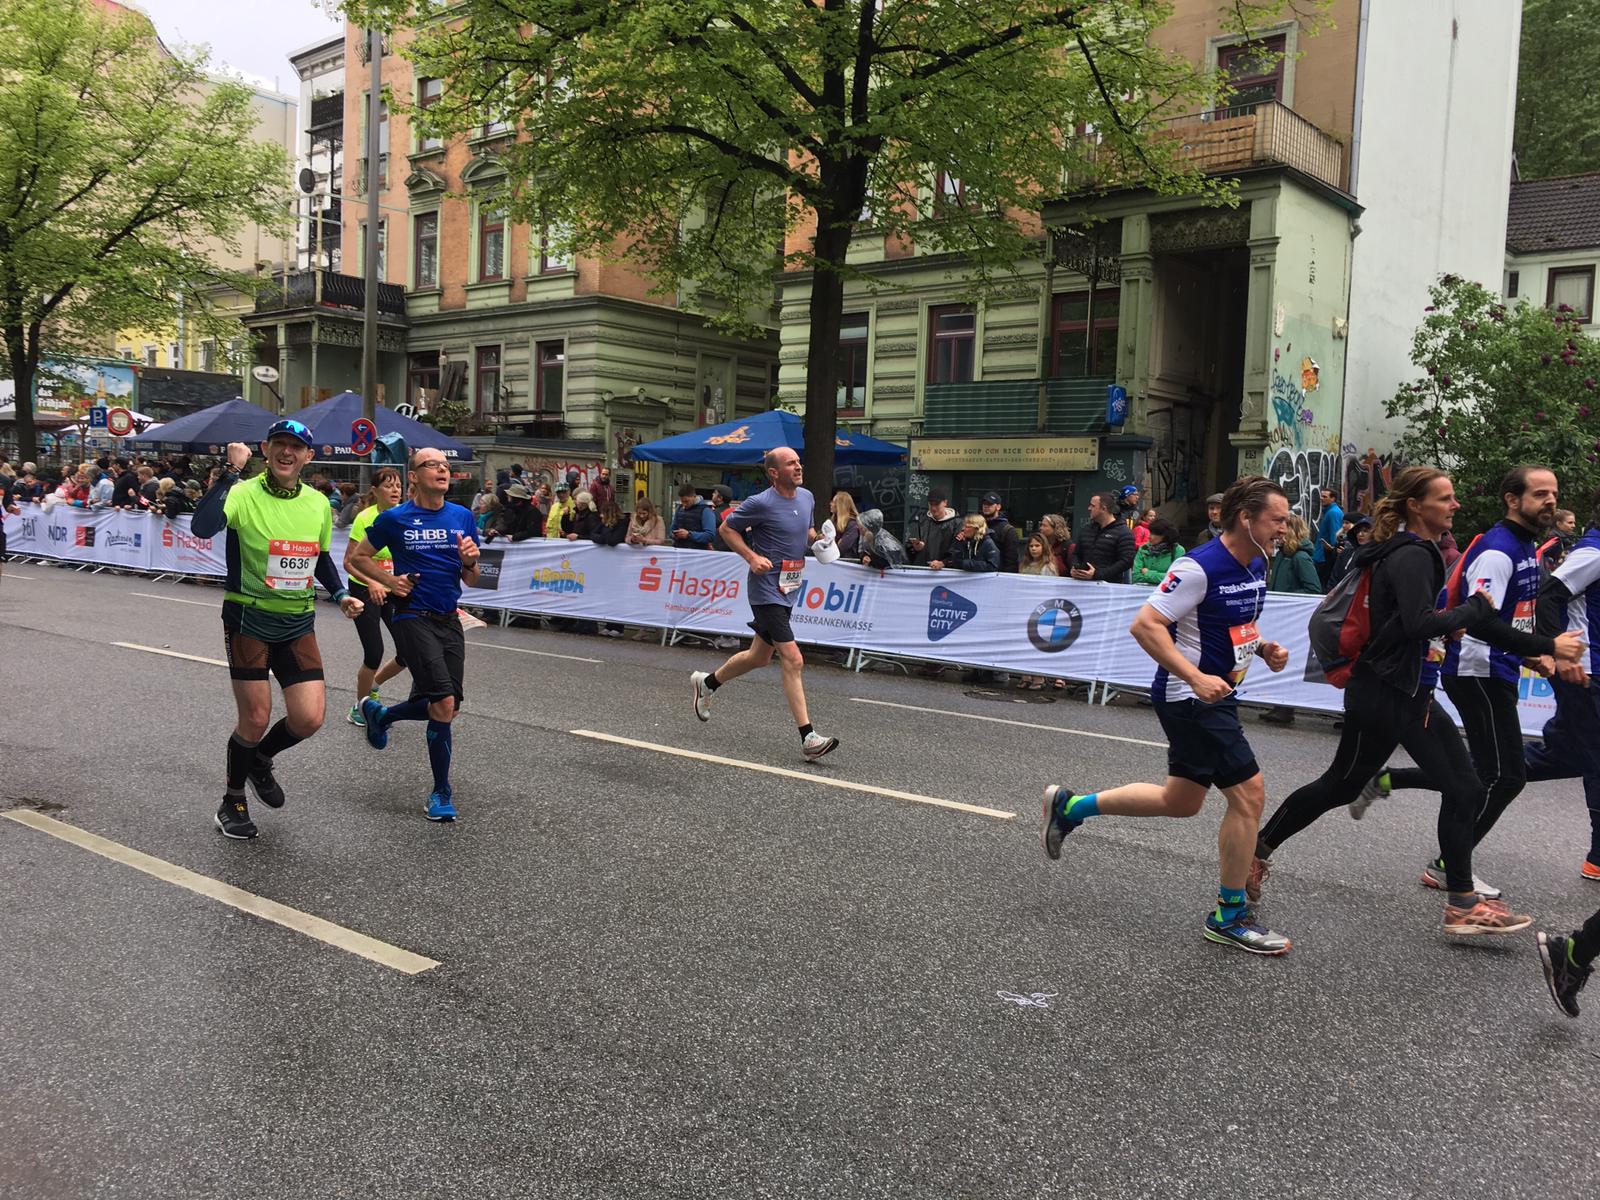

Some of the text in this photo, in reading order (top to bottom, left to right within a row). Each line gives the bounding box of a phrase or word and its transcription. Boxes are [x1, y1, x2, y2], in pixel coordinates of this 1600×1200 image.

[48, 525, 68, 542] NDR
[403, 528, 448, 541] SHBB
[279, 556, 310, 570] 6636
[668, 569, 740, 603] Haspa
[931, 607, 968, 621] ACTIVE
[930, 618, 954, 630] CITY
